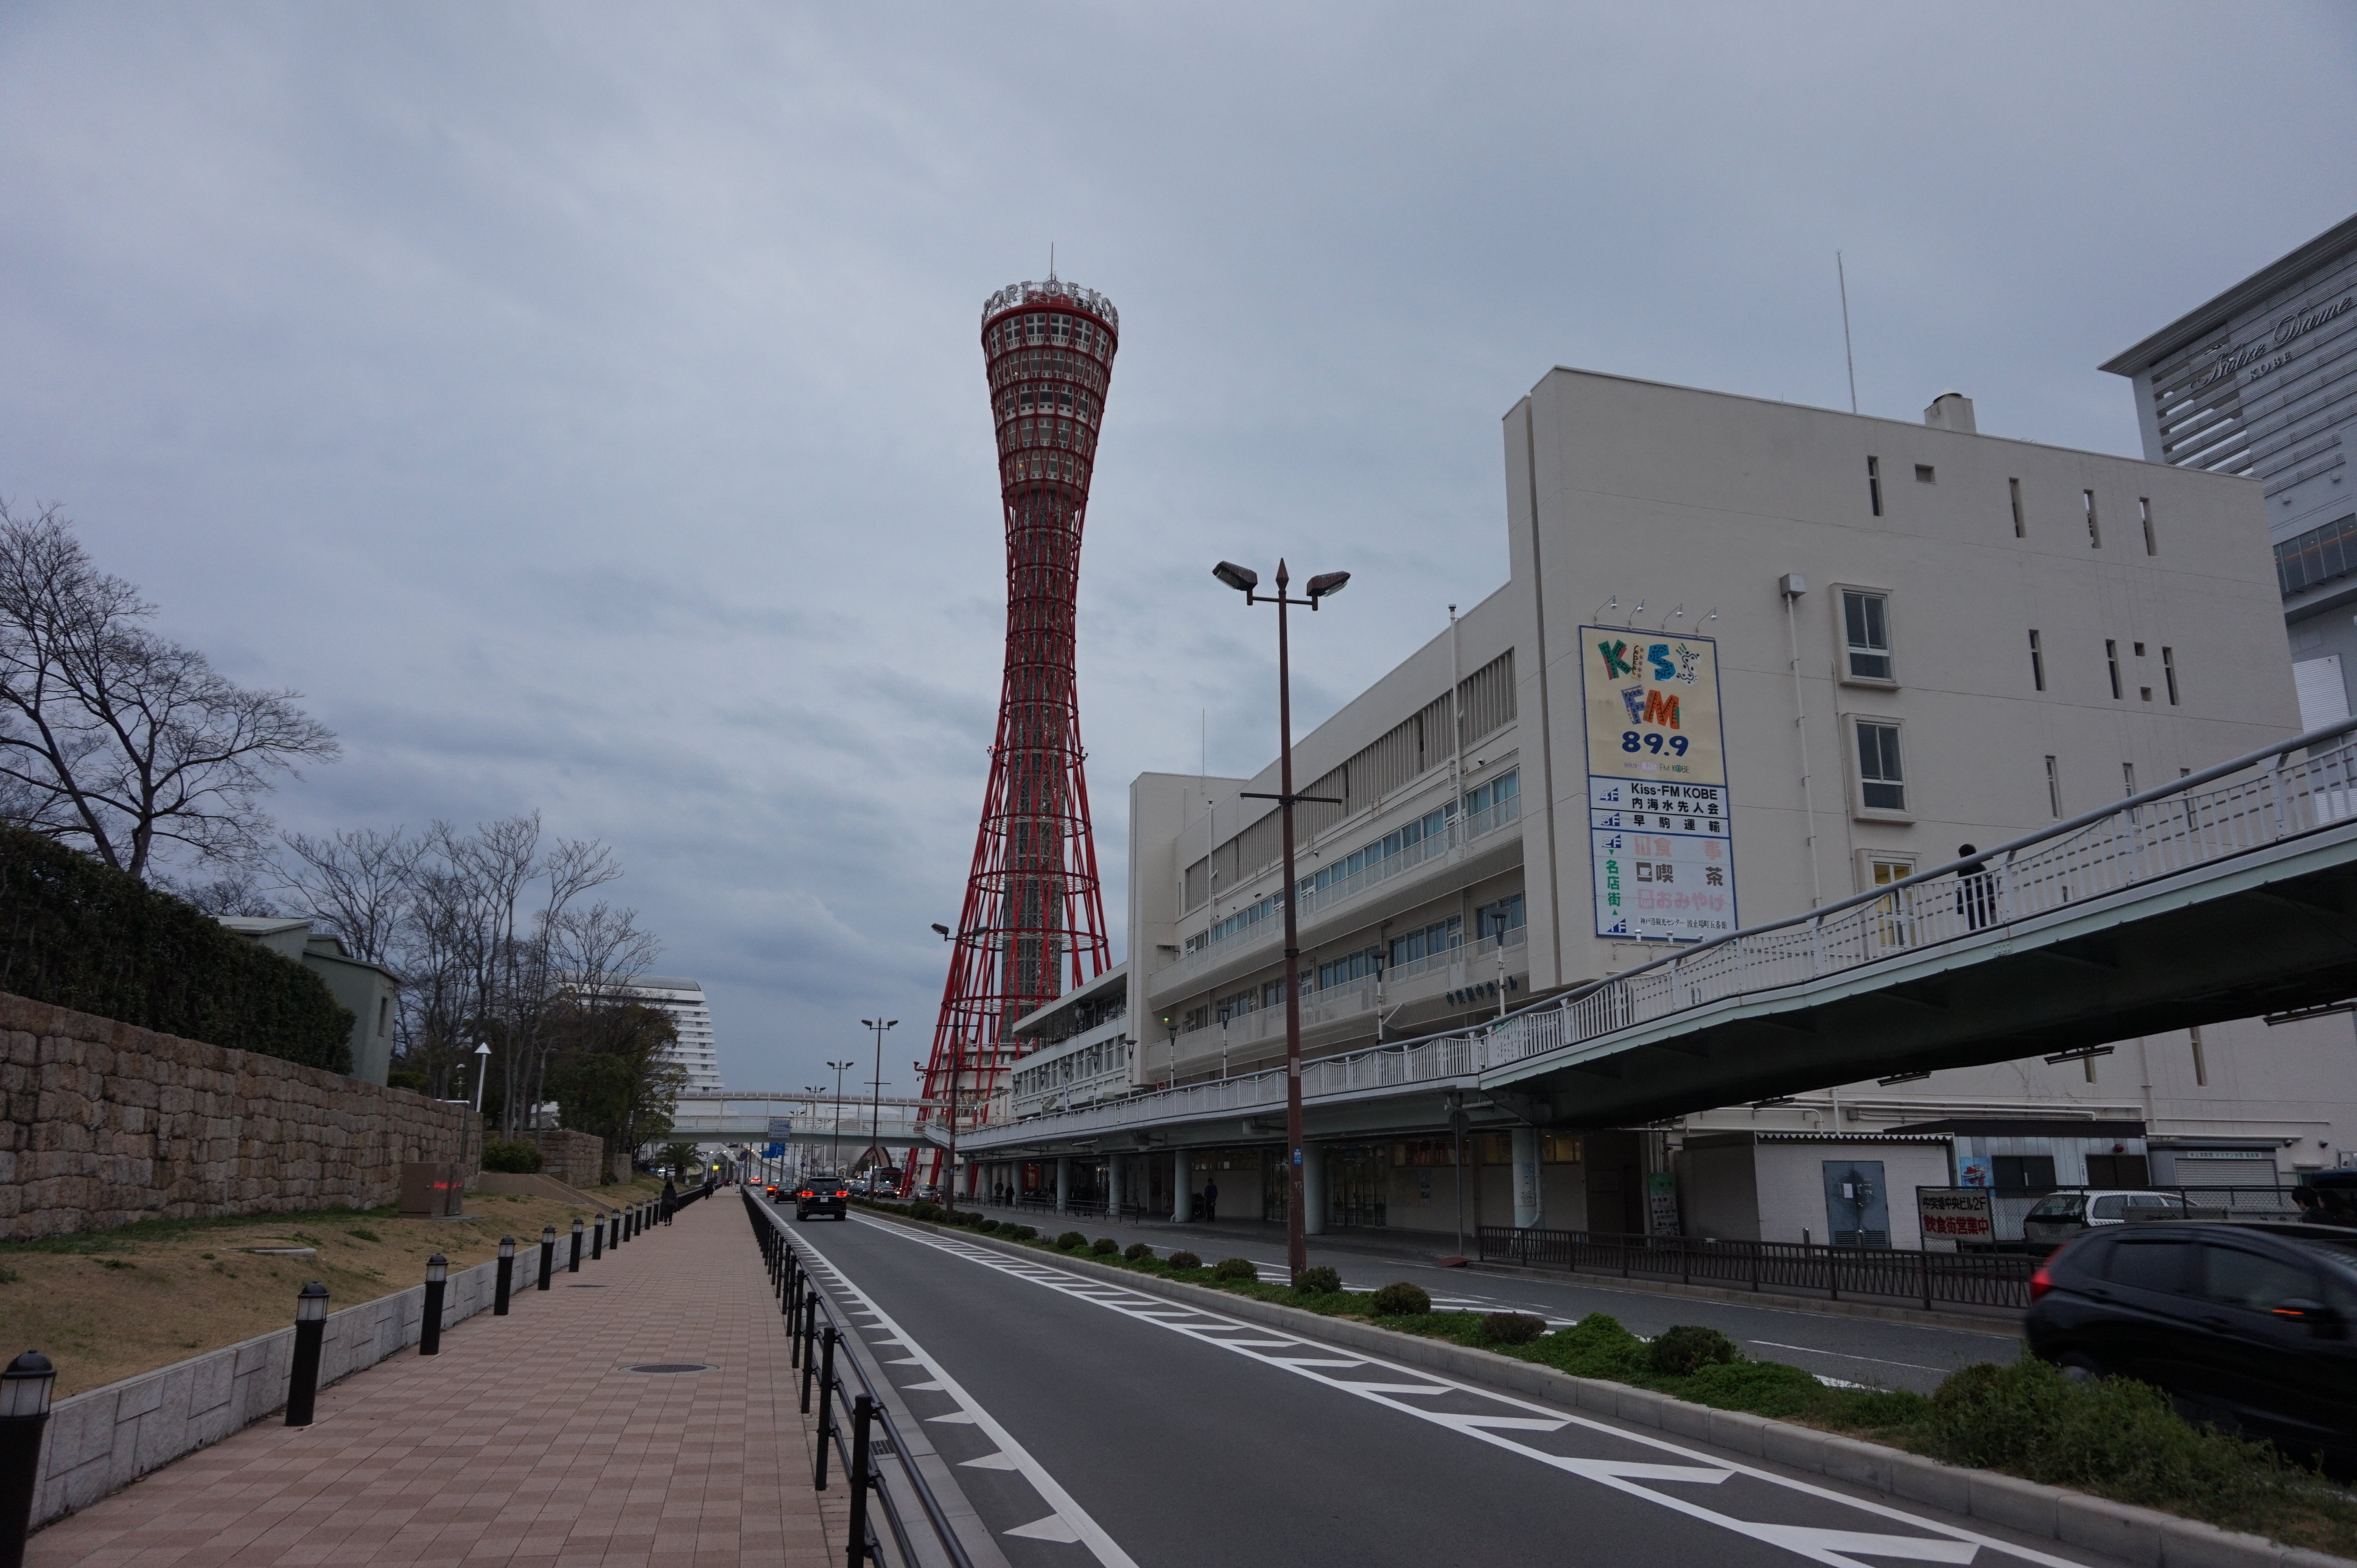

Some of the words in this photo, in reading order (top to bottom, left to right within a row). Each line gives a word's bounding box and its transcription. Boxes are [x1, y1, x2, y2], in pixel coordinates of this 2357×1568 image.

[984, 281, 1032, 318] PORT
[1043, 279, 1079, 299] OF
[2274, 296, 2352, 349] Dame
[2250, 351, 2292, 380] KOBE
[1621, 685, 1680, 729] FM
[1622, 731, 1689, 757] 89.9
[1672, 765, 1690, 773] KOBE
[1600, 790, 1619, 802] 4F
[1631, 783, 1680, 797] Kiss-FM
[1684, 786, 1718, 800] KOBE
[1632, 797, 1718, 815] 内海水先人会
[1601, 814, 1620, 827] 3F
[1634, 814, 1720, 833] 早駒運輸
[1602, 838, 1622, 849] 2F
[1654, 837, 1721, 861] 食事
[1606, 859, 1620, 906] 名店街
[1656, 864, 1723, 886] 喫茶
[1657, 891, 1725, 912] おみやげ
[1609, 921, 1627, 933] 1F
[1640, 917, 1685, 926] 神戸港観光センター
[1687, 919, 1728, 929] 波止場町五番館
[1923, 1214, 1989, 1235] 飲食街営業中
